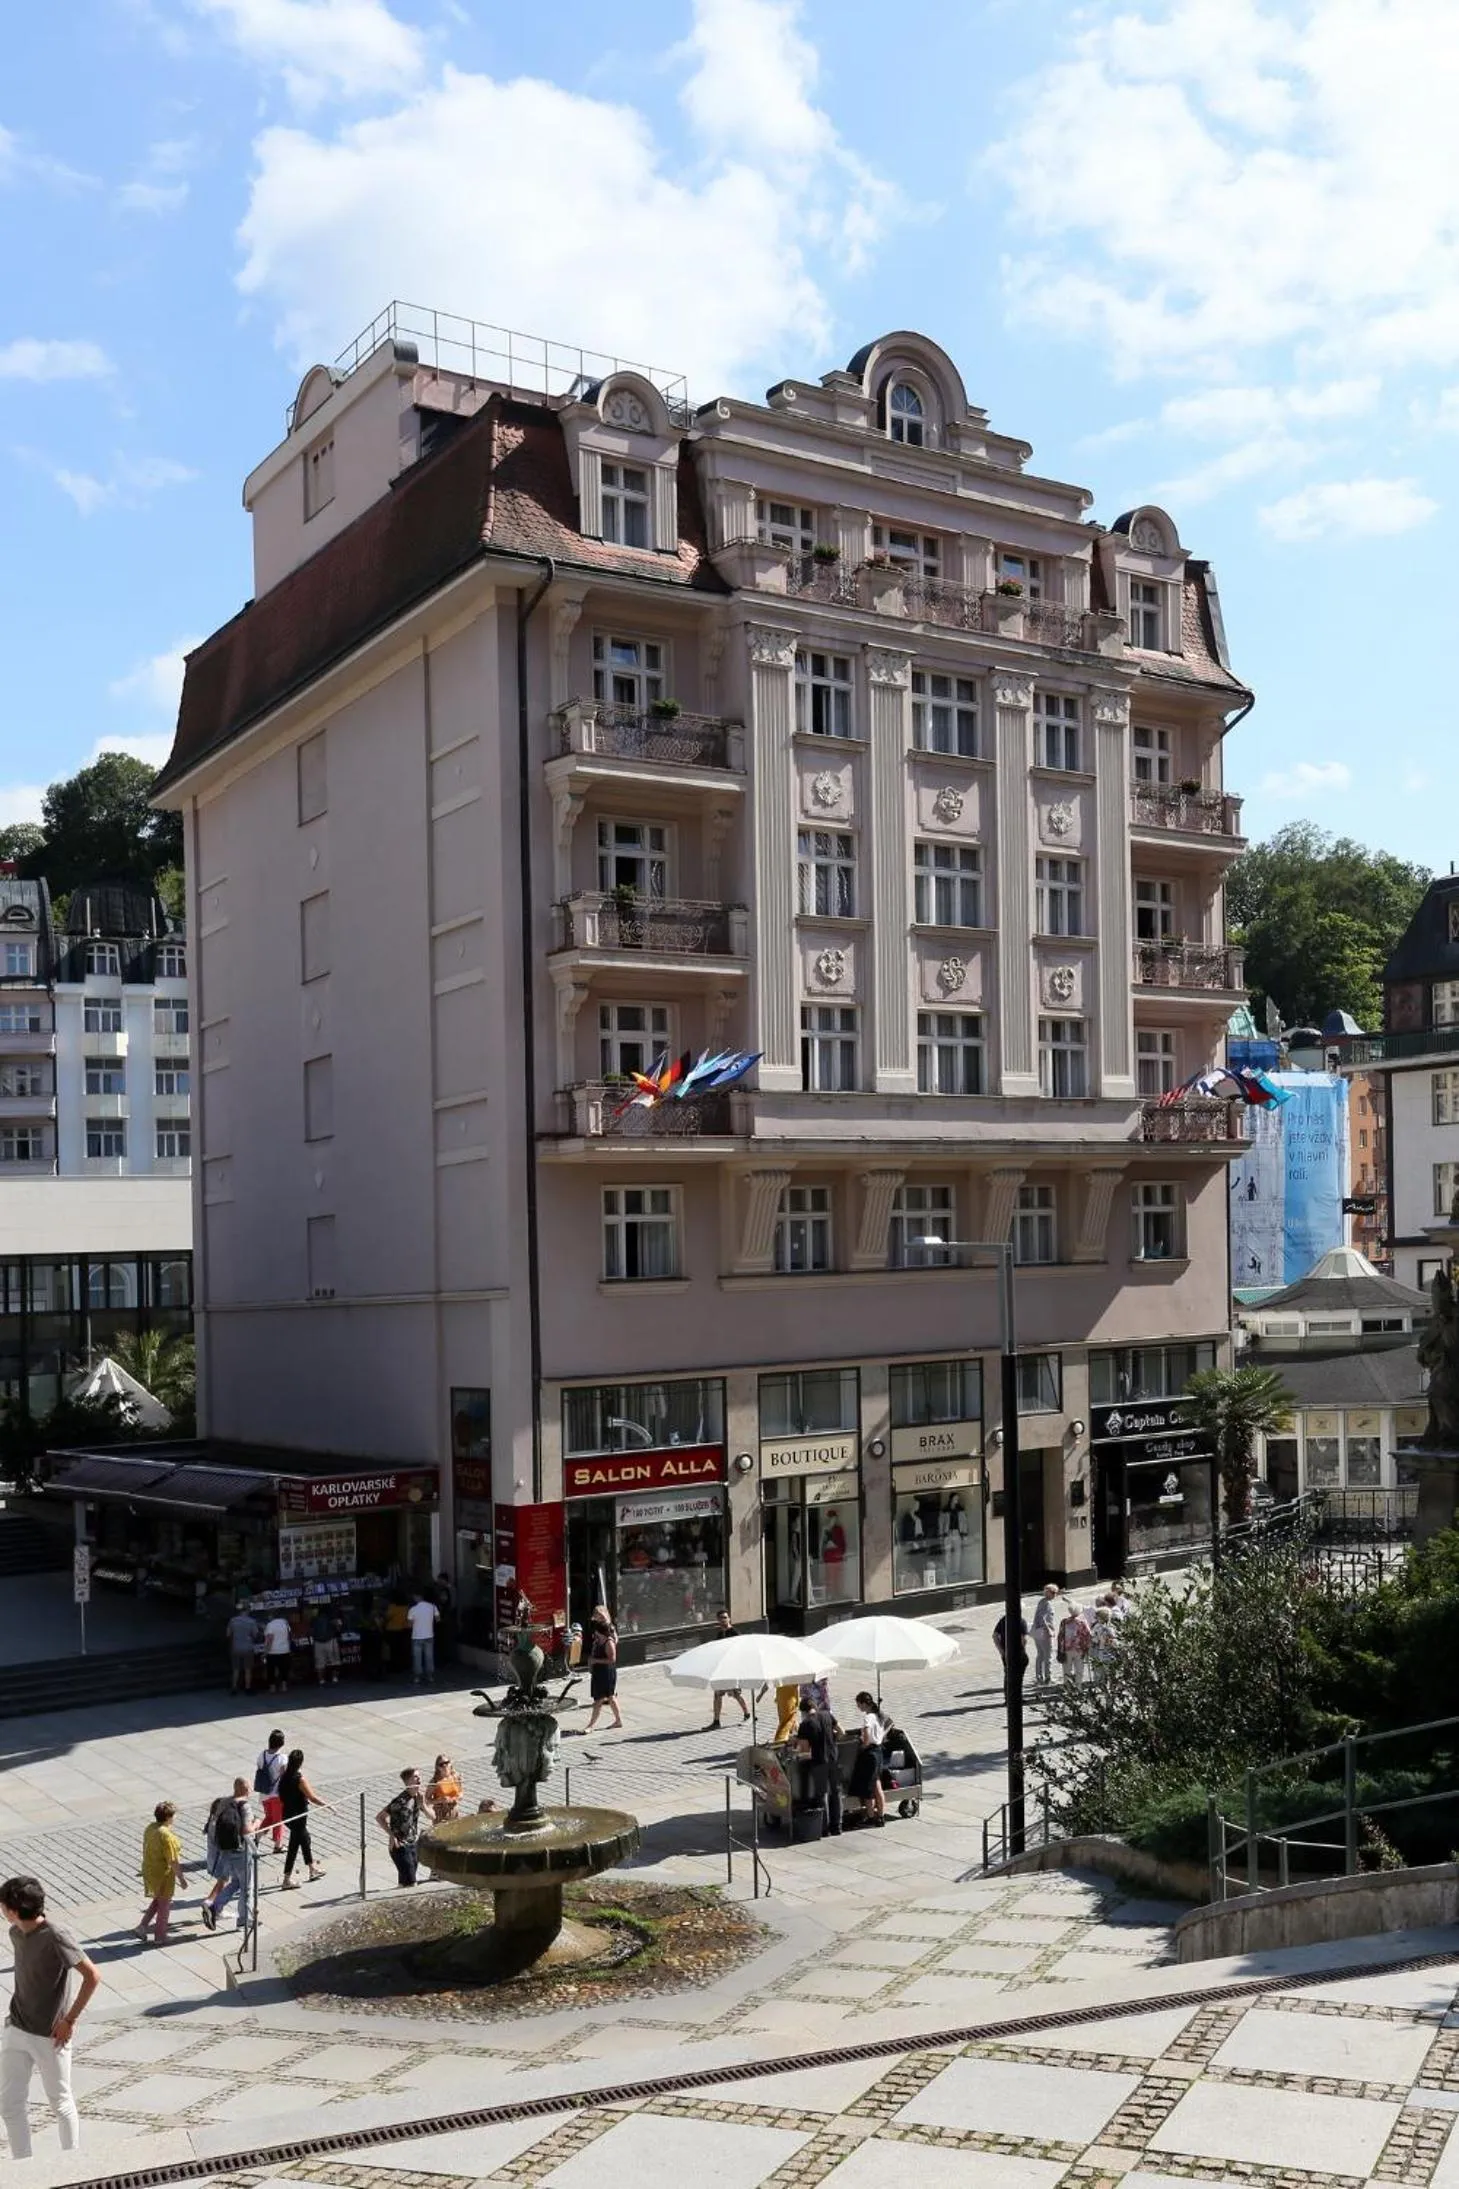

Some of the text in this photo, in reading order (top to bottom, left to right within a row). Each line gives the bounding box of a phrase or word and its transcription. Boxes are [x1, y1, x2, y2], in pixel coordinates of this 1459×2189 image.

[1289, 1152, 1295, 1162] v
[1124, 1413, 1166, 1430] Captain
[919, 1433, 955, 1447] BRAX
[770, 1446, 849, 1467] BOUTIQUE
[573, 1458, 717, 1486] SALON ALLA
[311, 1474, 397, 1496] KARLOVARSKÉ
[327, 1491, 381, 1509] OPLATKY
